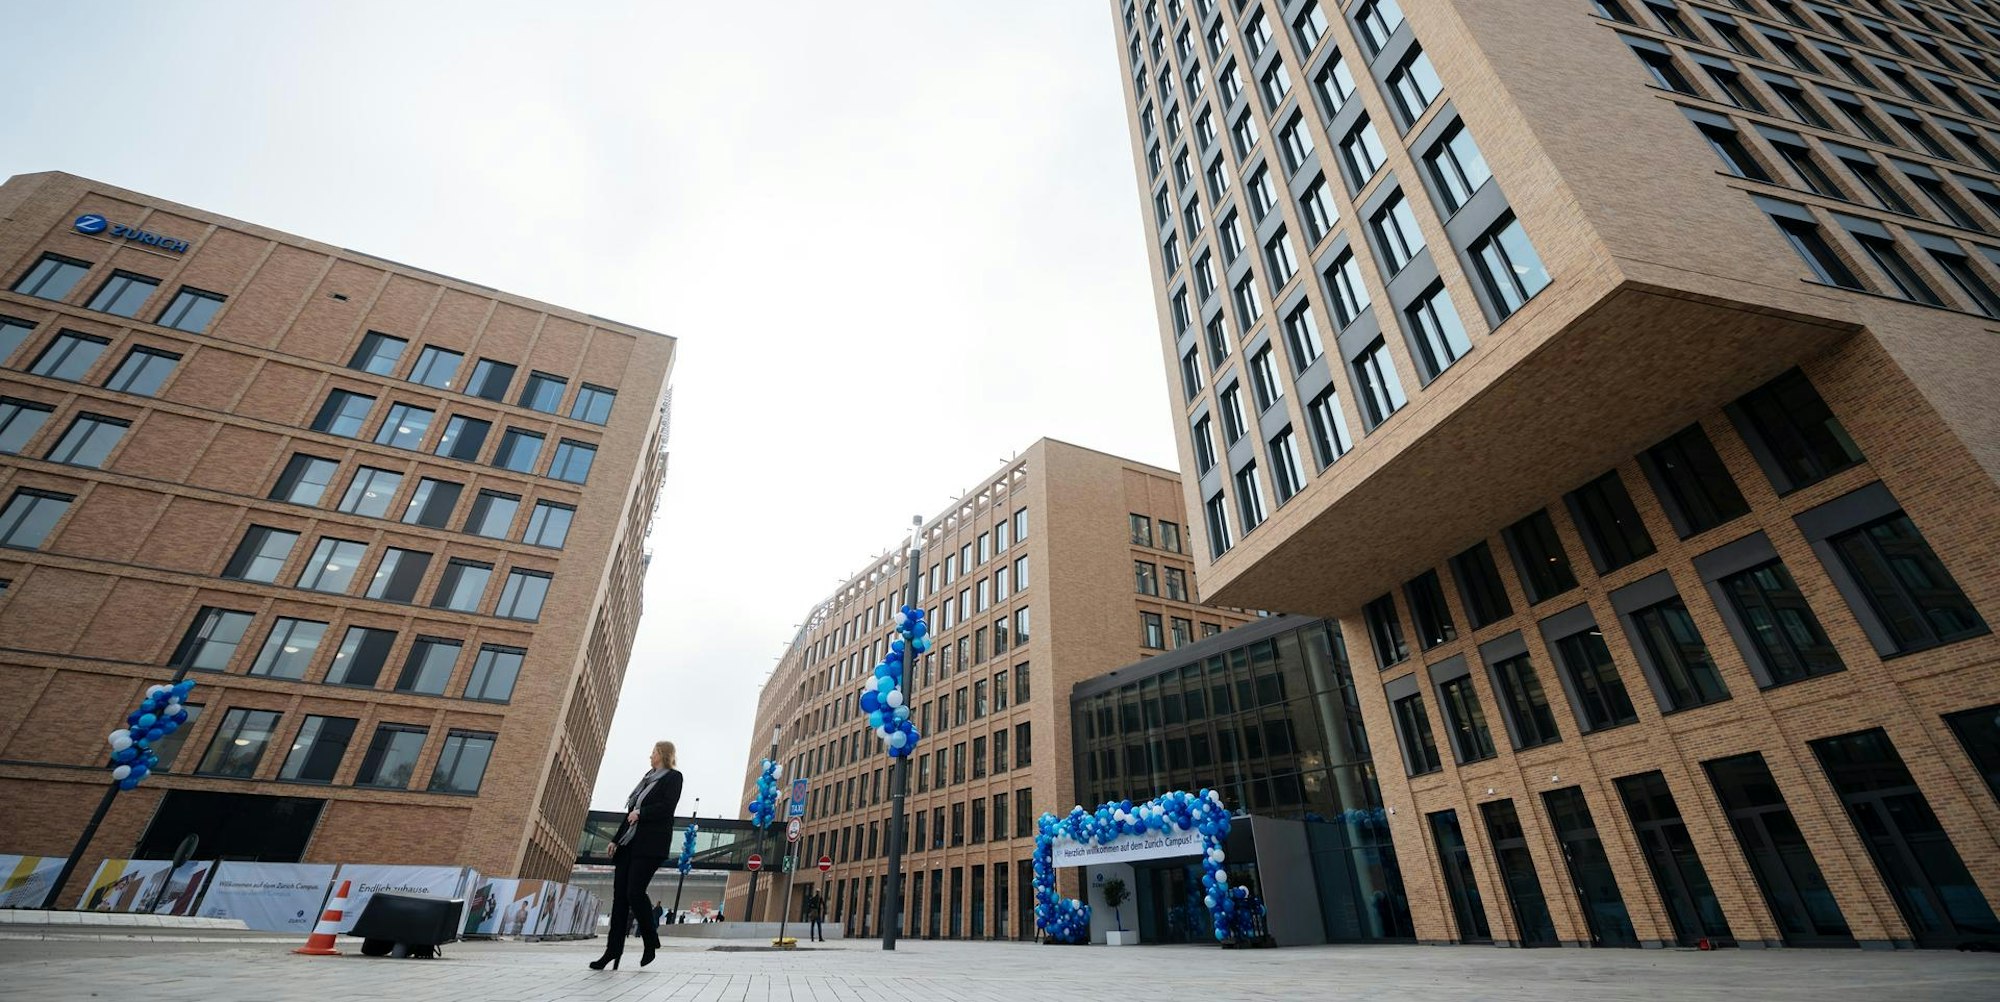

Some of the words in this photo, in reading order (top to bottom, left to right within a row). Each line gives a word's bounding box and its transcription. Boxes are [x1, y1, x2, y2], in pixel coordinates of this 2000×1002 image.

[109, 223, 190, 254] ZURICH
[791, 804, 804, 814] TAXI
[1064, 847, 1086, 858] Herzlich
[1086, 845, 1119, 856] willkommen
[1120, 841, 1130, 852] auf
[1130, 841, 1144, 851] dem
[1144, 838, 1164, 849] Zurich
[1164, 835, 1193, 848] Campus!
[219, 880, 252, 889] Willkommen
[253, 881, 264, 889] auf
[263, 881, 276, 889] dem
[276, 881, 295, 890] Zurich
[358, 883, 391, 893] Endlich
